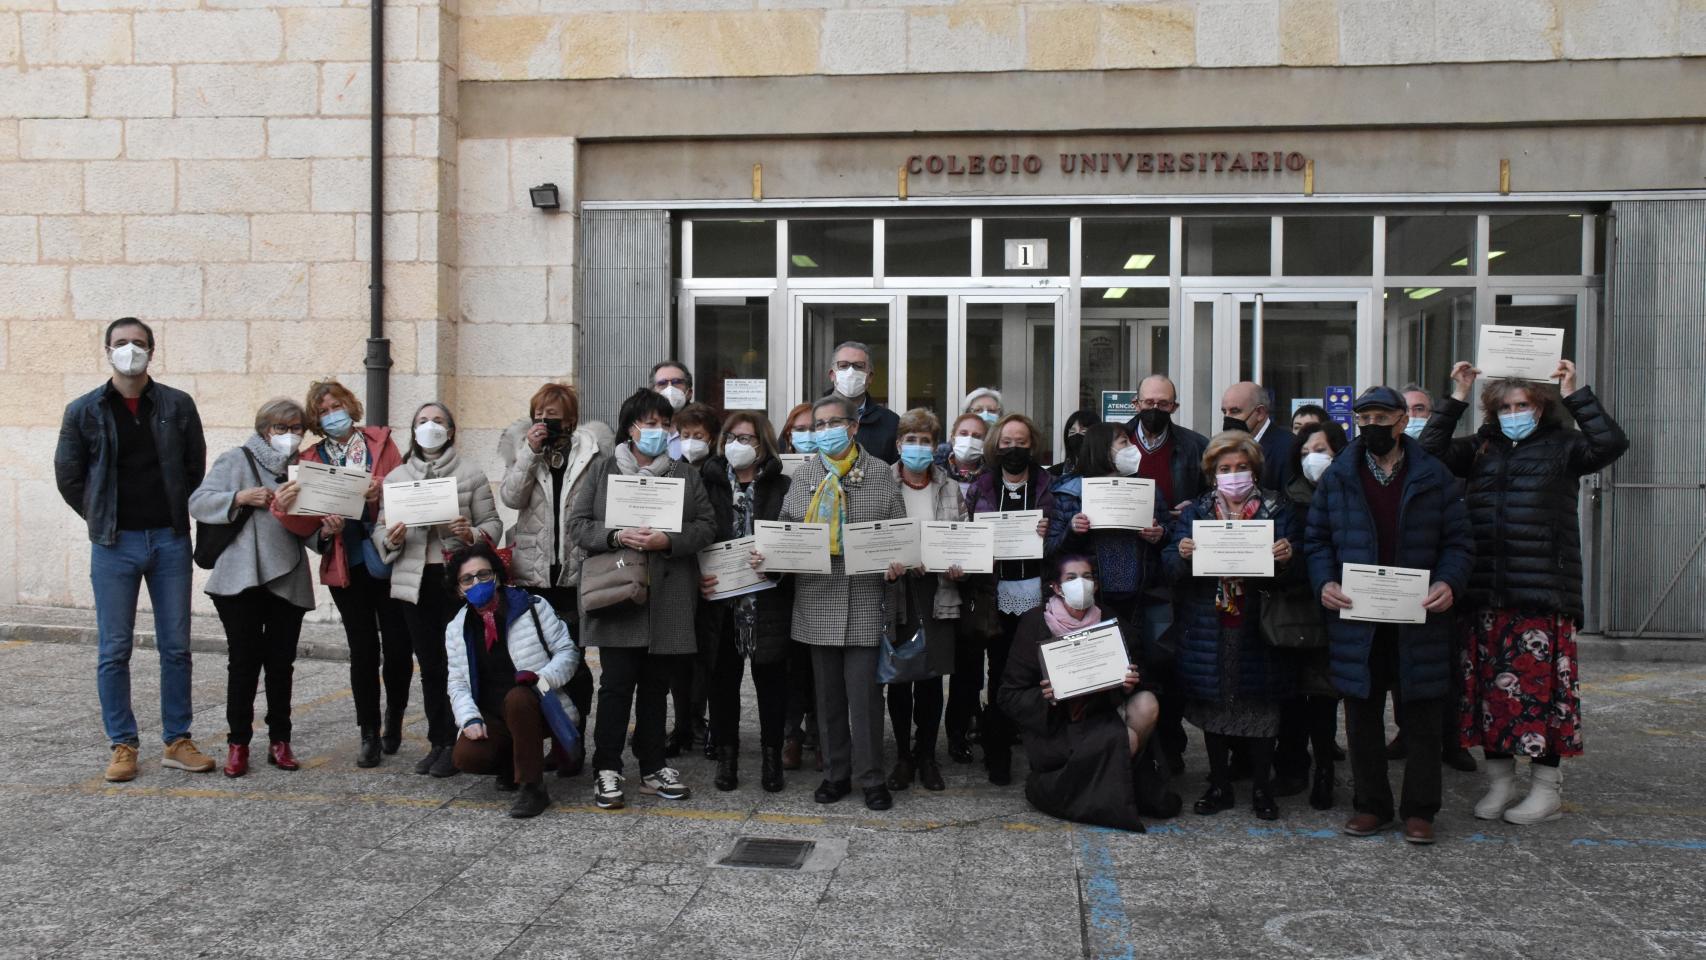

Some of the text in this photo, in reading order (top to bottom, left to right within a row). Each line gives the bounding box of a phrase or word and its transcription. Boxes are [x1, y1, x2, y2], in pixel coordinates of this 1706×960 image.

[906, 150, 1307, 175] COLEGIO UNIVERSITARIO
[1021, 246, 1030, 266] 1
